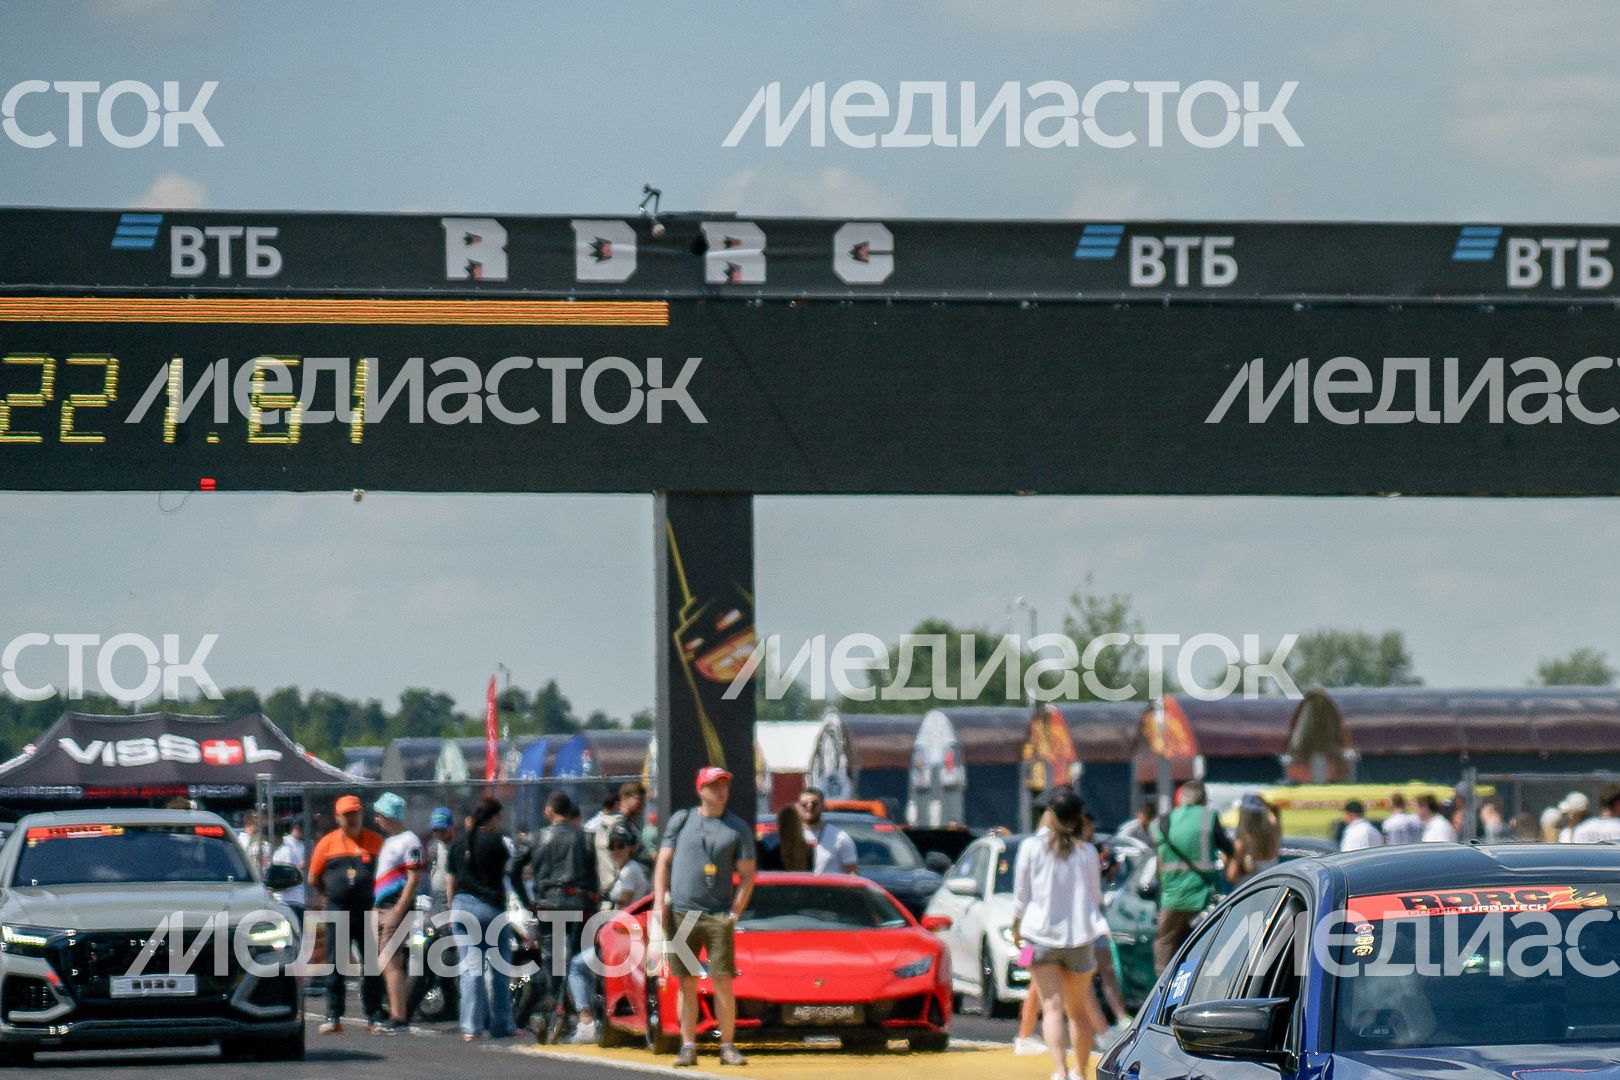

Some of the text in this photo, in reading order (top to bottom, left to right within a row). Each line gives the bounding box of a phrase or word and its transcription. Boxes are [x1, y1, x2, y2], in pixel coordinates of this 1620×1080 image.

[170, 226, 284, 279] ВТБ
[1129, 236, 1239, 287] ВТБ
[1506, 238, 1613, 290] ВТБ
[1398, 889, 1551, 911] RDRC
